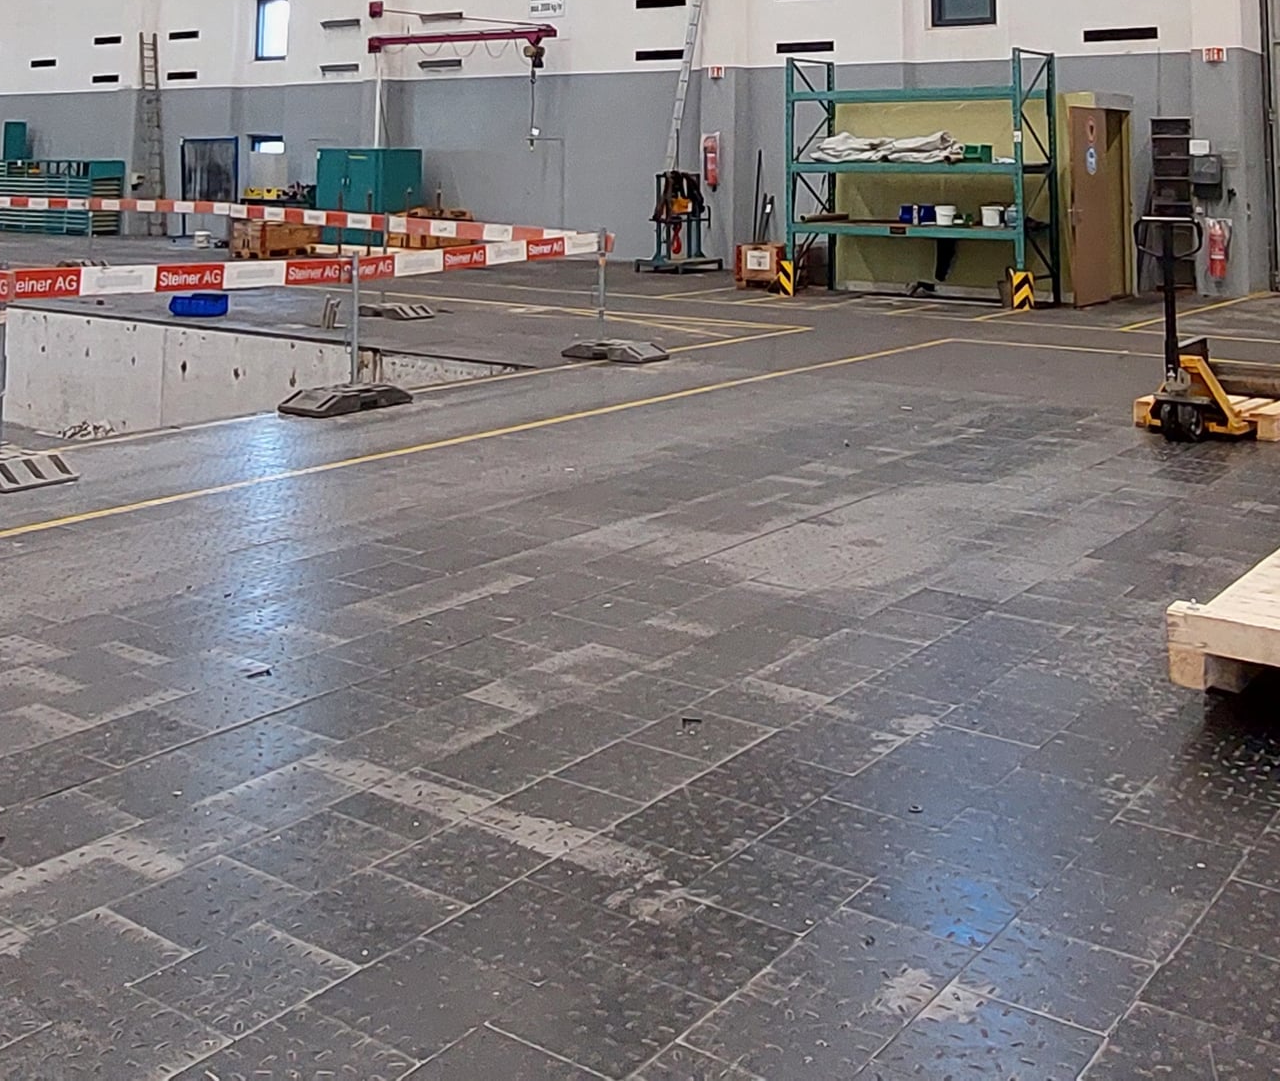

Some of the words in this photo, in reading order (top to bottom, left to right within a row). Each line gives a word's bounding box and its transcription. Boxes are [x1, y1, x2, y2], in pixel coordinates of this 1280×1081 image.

[552, 241, 564, 252] AG
[377, 260, 393, 273] AG
[444, 253, 471, 267] Steiner
[471, 250, 485, 262] AG
[159, 271, 201, 286] Steiner
[202, 269, 222, 284] AG
[288, 267, 323, 281] Steiner
[323, 265, 340, 279] AG
[54, 275, 78, 291] AG
